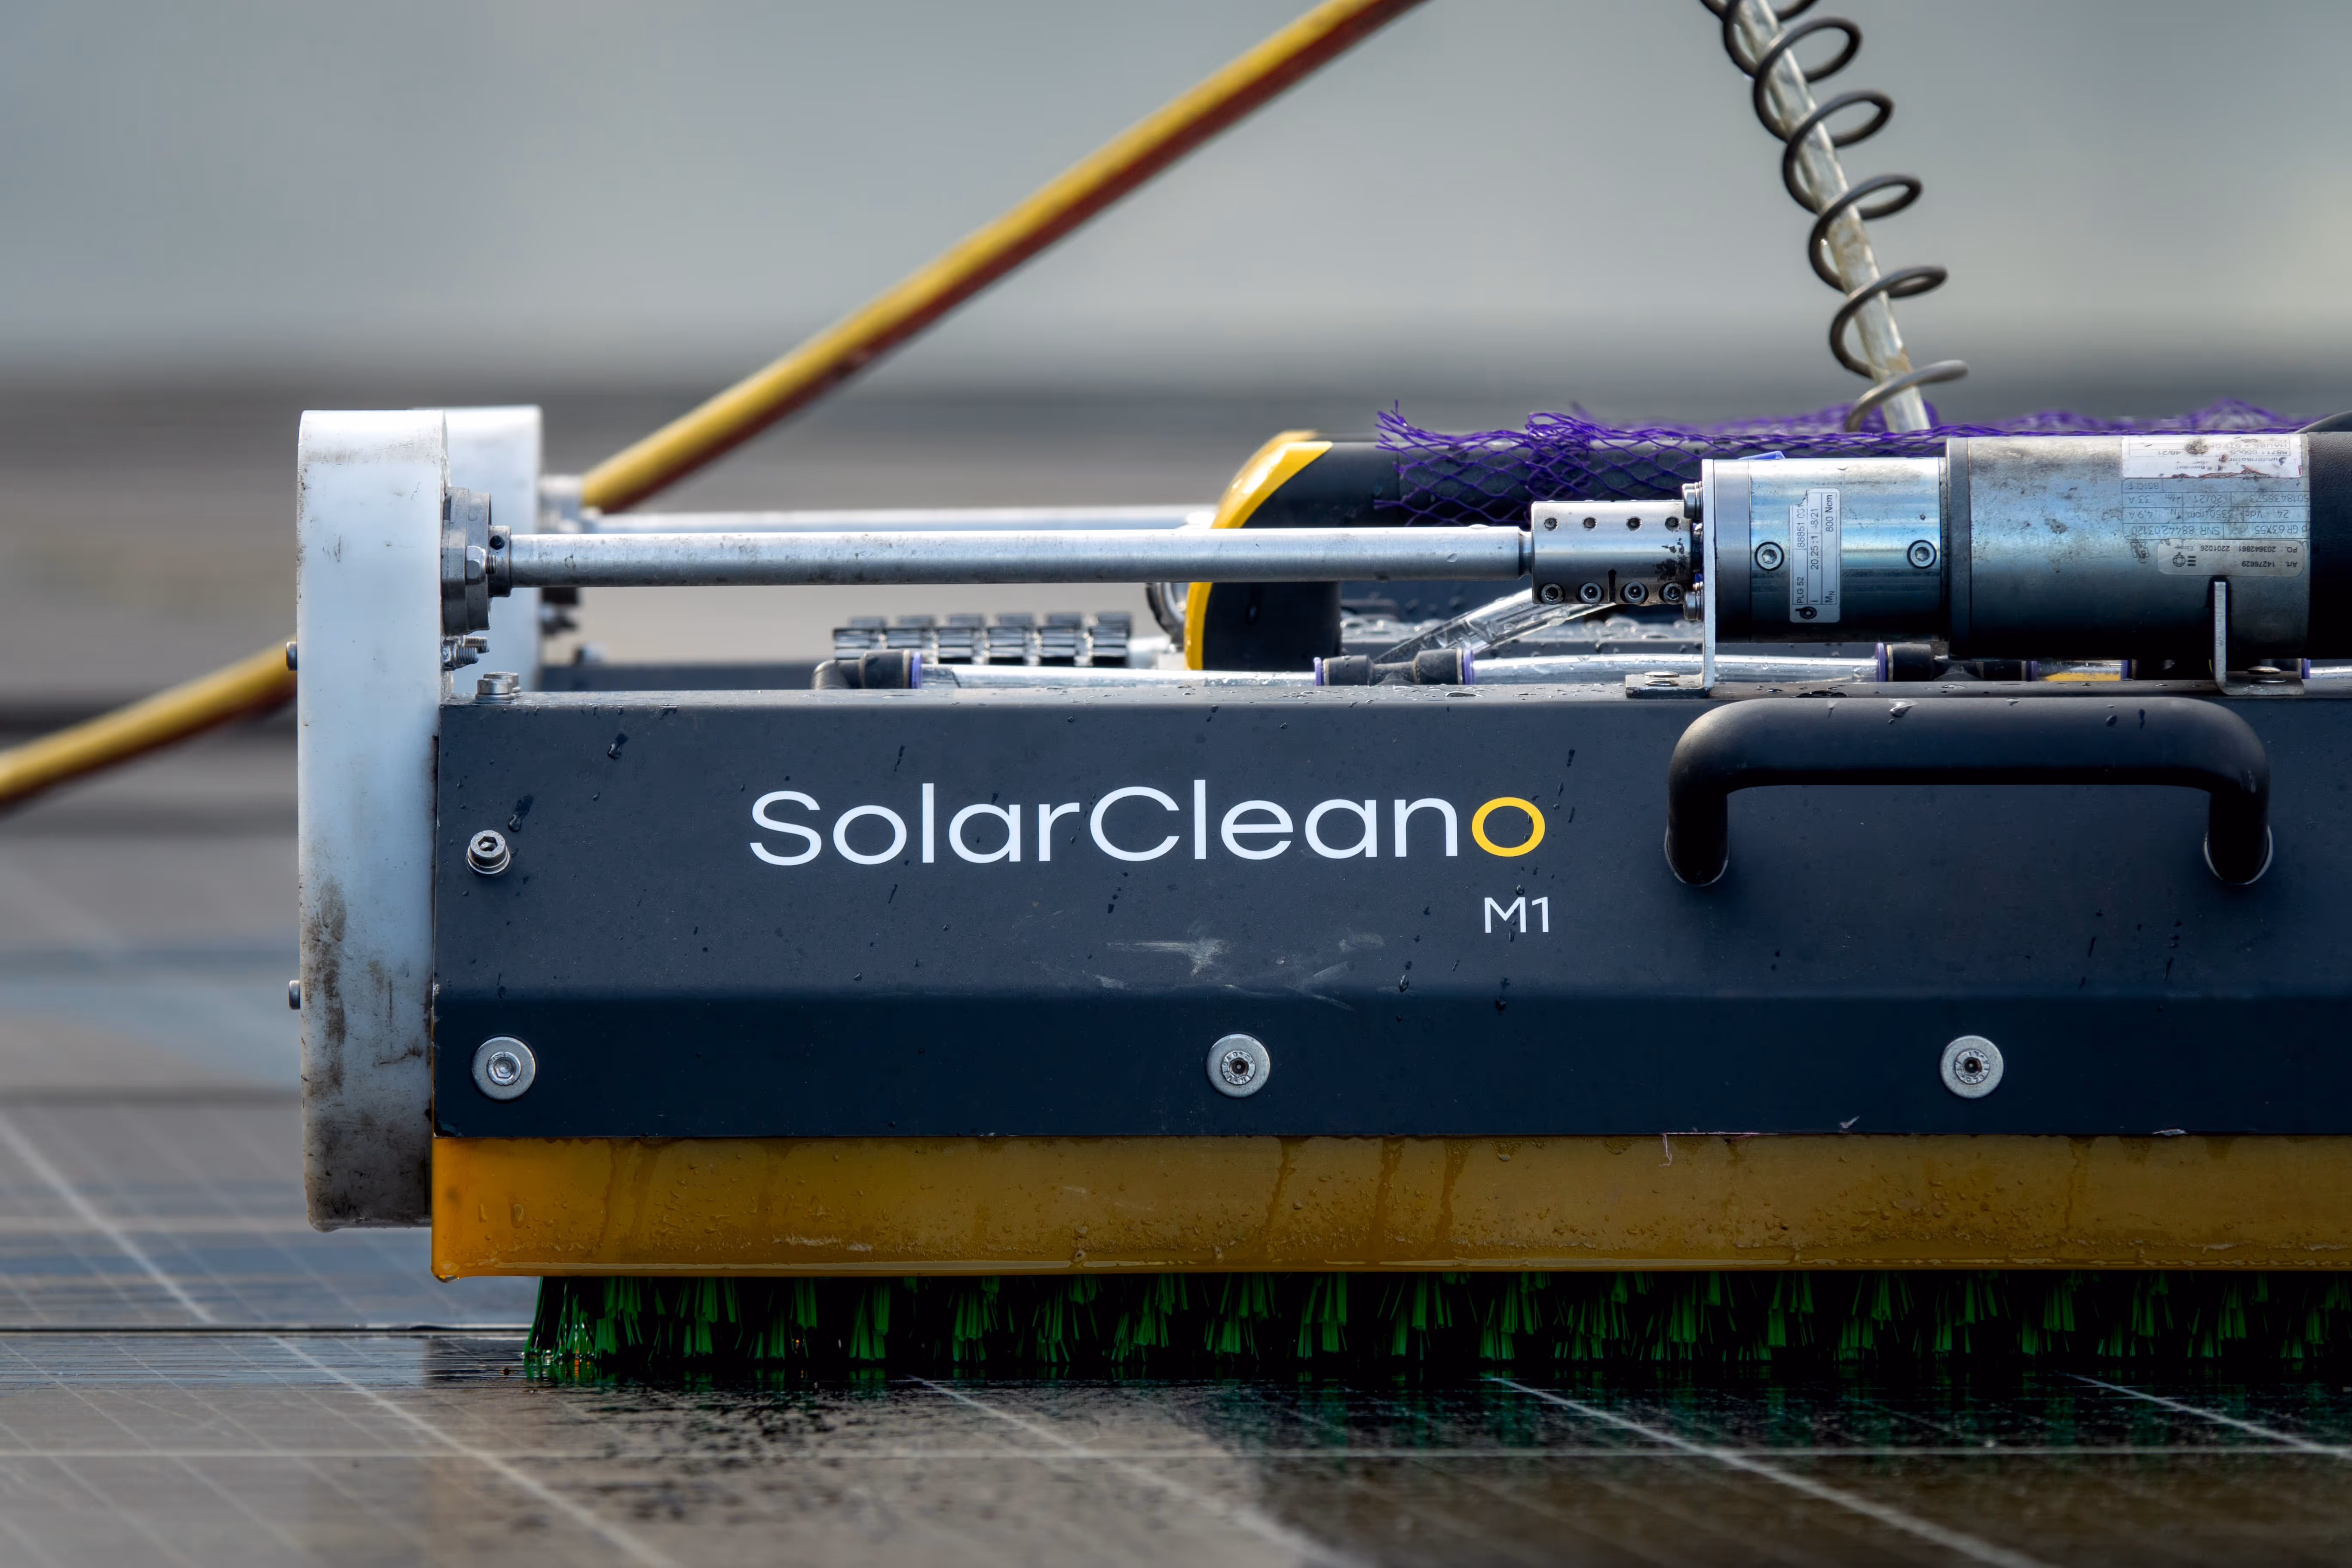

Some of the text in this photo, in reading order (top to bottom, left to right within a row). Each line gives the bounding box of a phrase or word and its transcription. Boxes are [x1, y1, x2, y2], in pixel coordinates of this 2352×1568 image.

[2138, 495, 2150, 504] 33
[1825, 494, 1834, 532] 800 Ncm
[2277, 510, 2289, 518] 24
[2200, 526, 2220, 535] SNR
[1797, 576, 1804, 586] 52
[750, 780, 1545, 866] SolarCleano
[1485, 897, 1549, 933] M1
